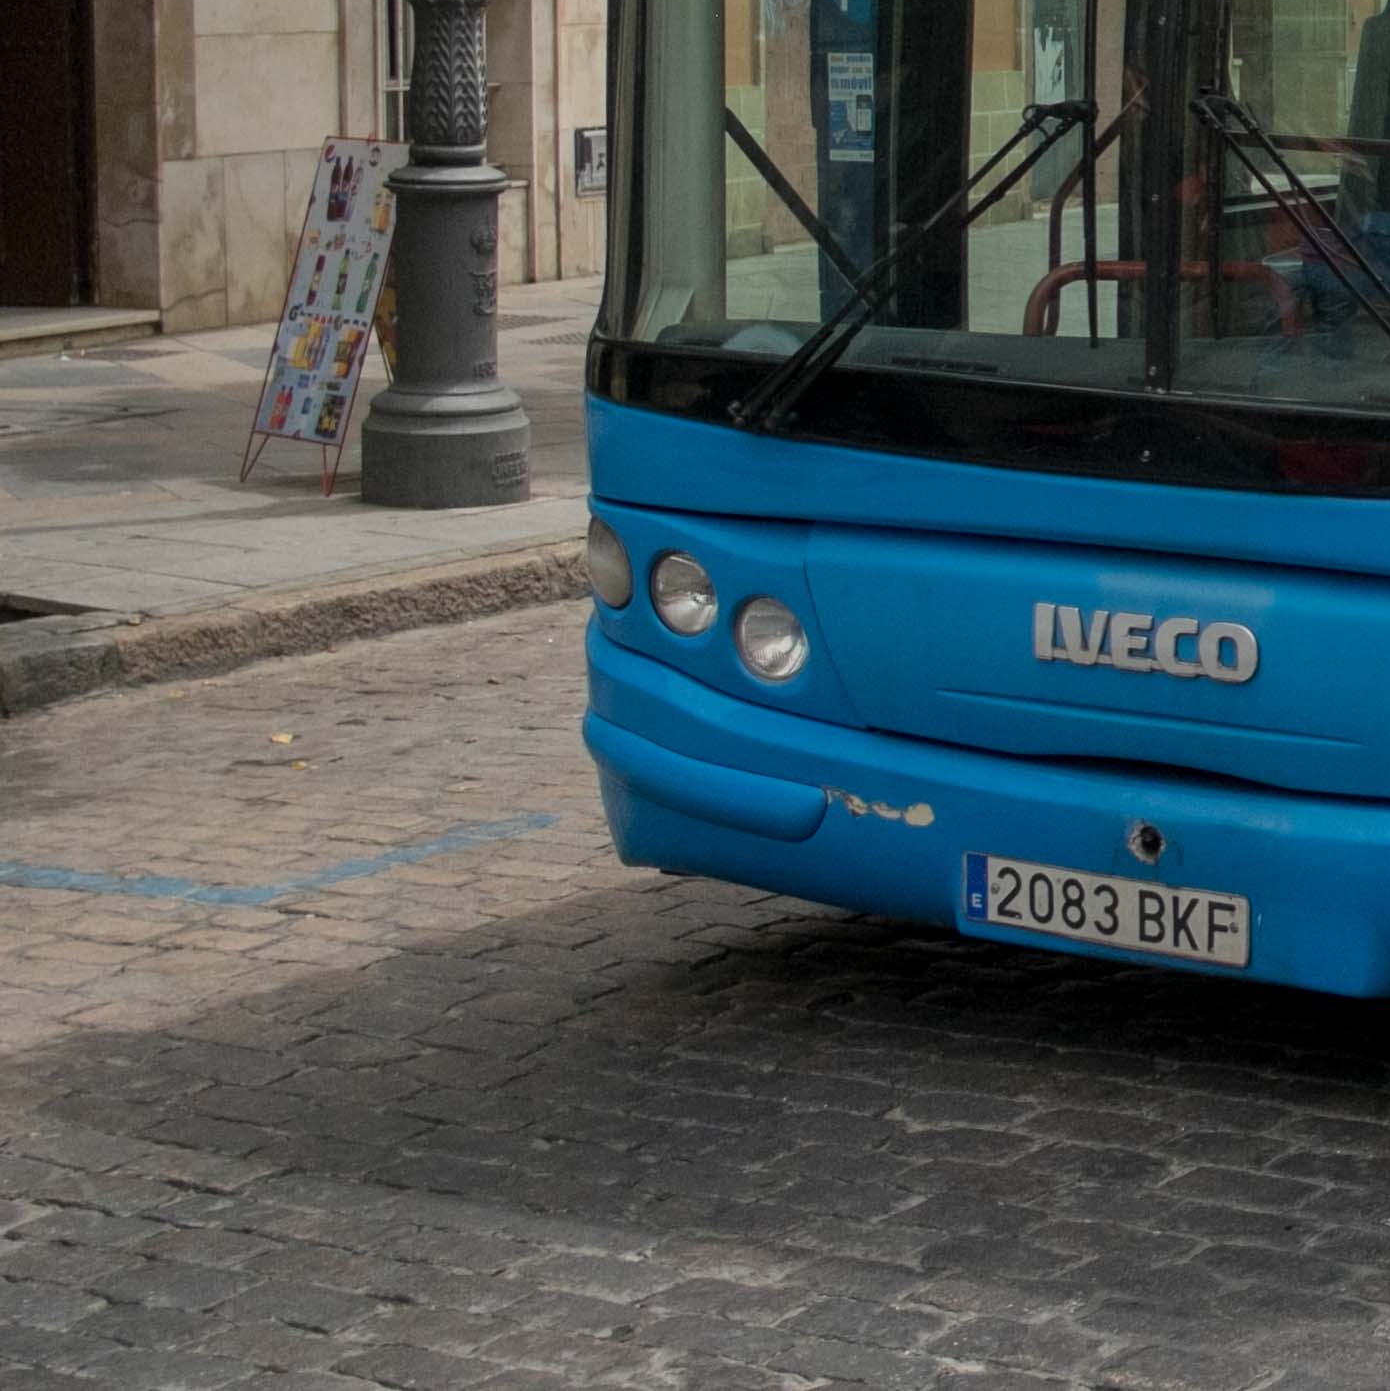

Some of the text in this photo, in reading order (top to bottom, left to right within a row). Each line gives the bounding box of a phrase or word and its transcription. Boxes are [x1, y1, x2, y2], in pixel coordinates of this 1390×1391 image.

[1034, 602, 1258, 683] IVECO
[972, 893, 982, 908] E
[997, 866, 1237, 953] 2083 BKF
